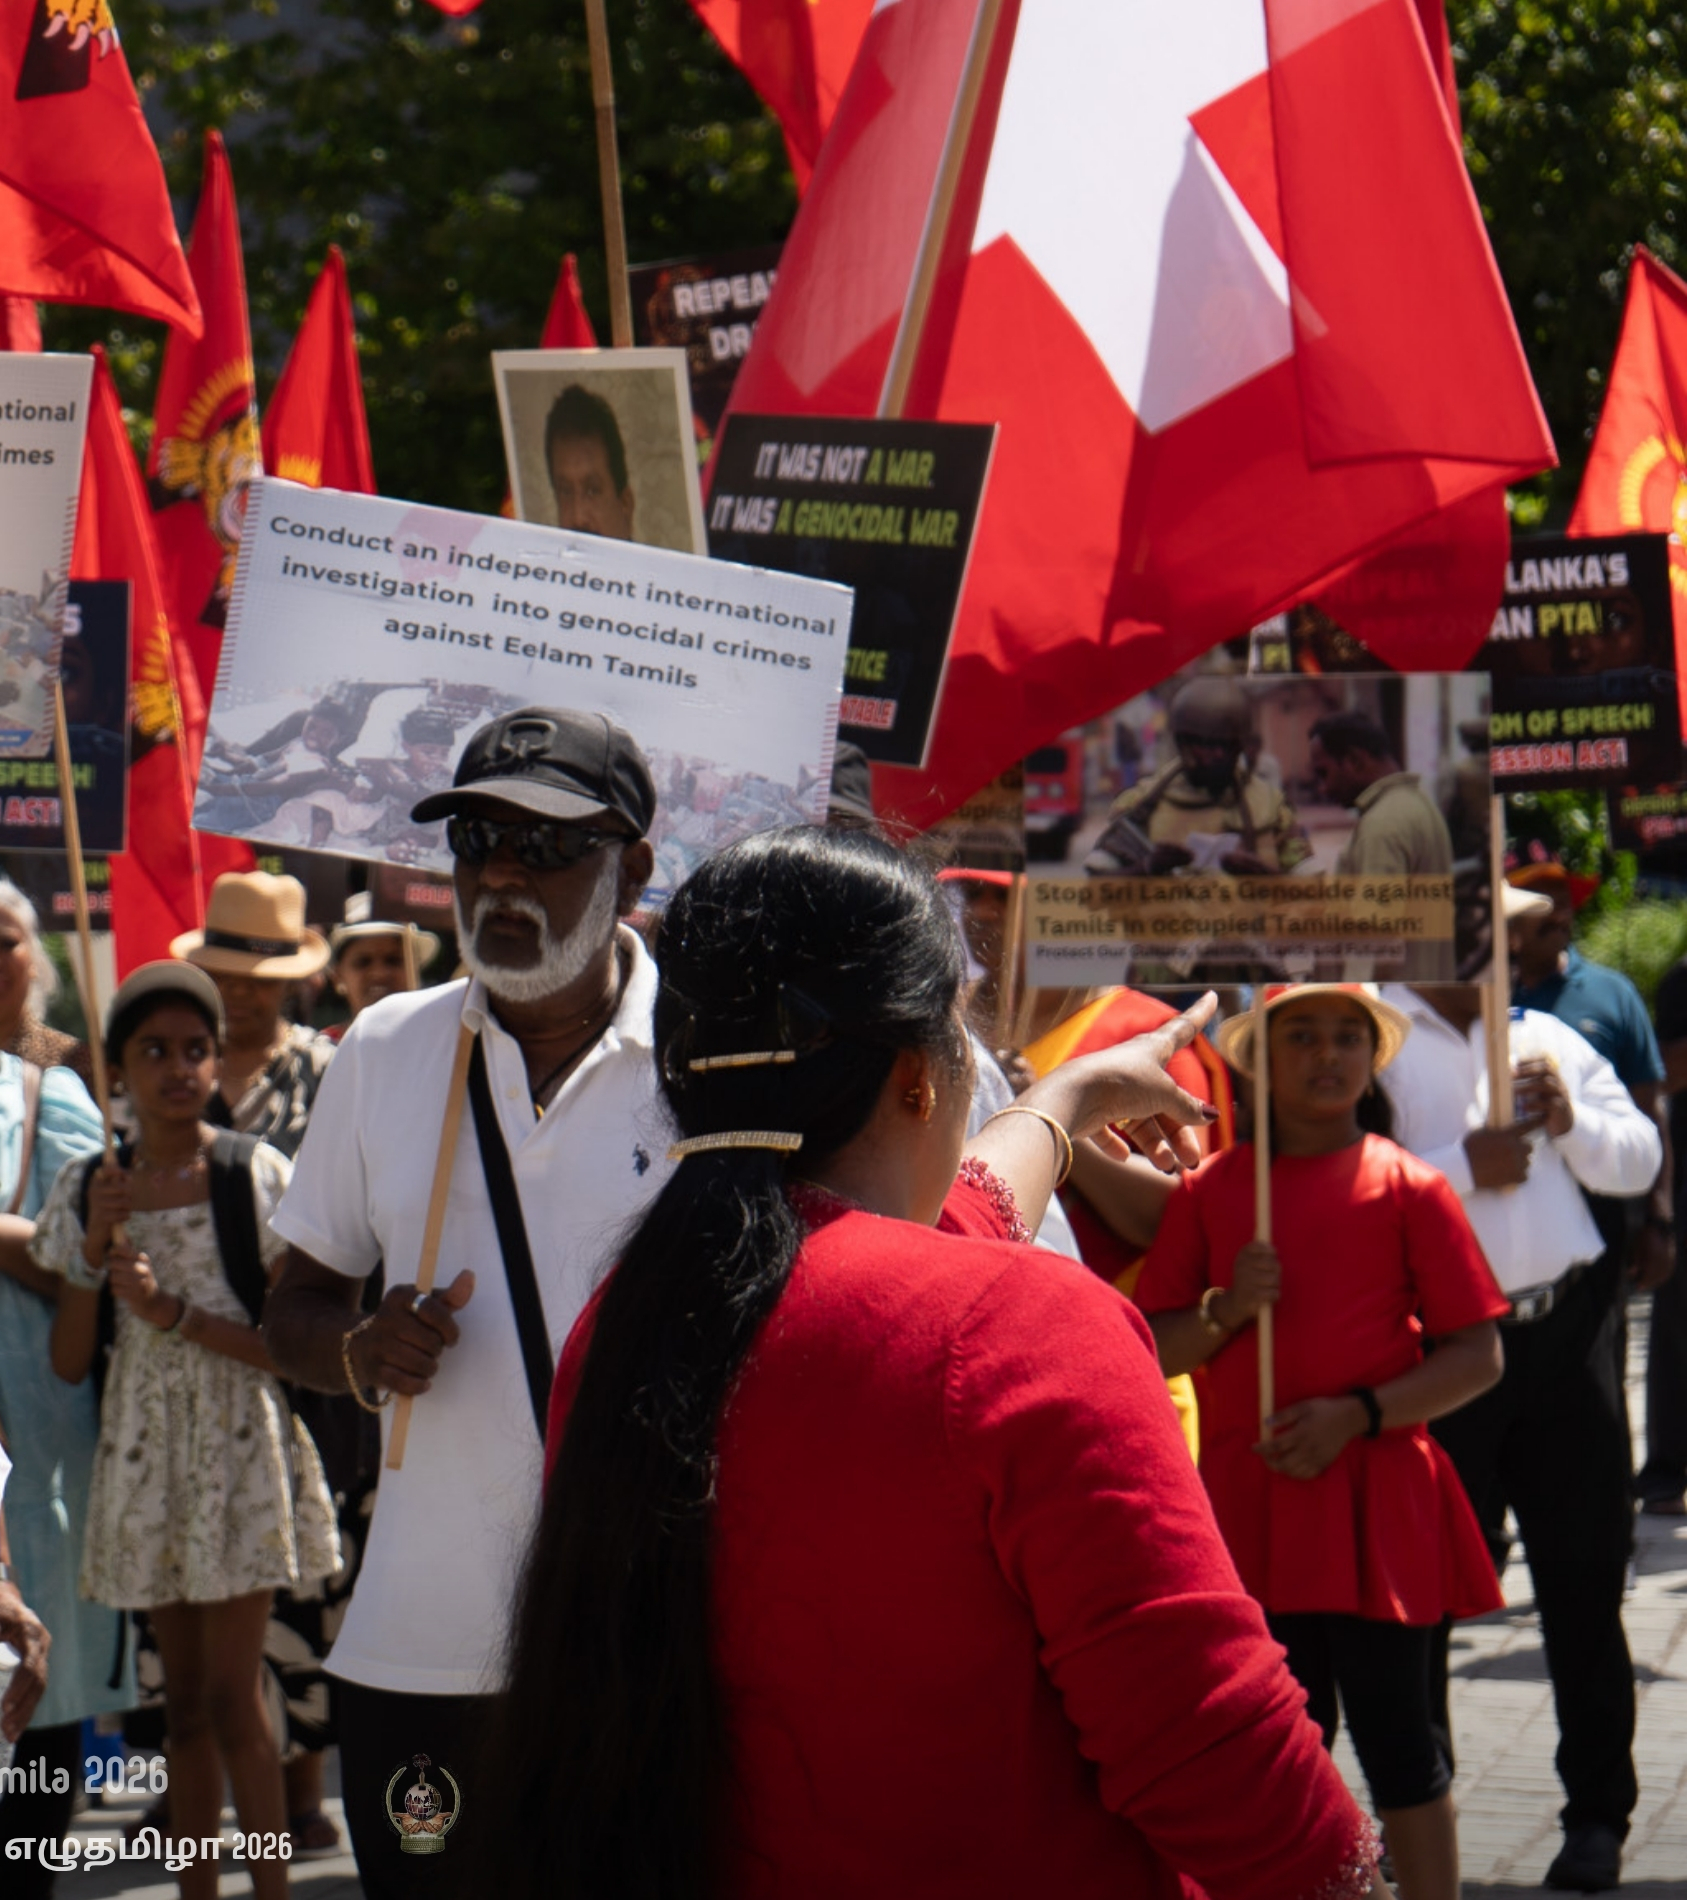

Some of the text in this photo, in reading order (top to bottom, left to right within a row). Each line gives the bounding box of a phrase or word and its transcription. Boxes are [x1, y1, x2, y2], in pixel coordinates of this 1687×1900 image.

[754, 442, 779, 479] IT
[777, 443, 822, 481] WAS
[821, 446, 867, 484] NOT
[864, 448, 883, 485] A
[710, 494, 733, 531] IT
[731, 496, 778, 534] WAS
[774, 498, 792, 535] A
[793, 502, 906, 544] GENOCIDAL
[270, 516, 835, 636] Conduct an independent international
[1505, 553, 1629, 593] LANKA'S
[282, 556, 812, 671] investigation into genocidal crimes
[1539, 602, 1602, 637] PTA!
[384, 617, 698, 688] against Eelam Tamils
[844, 648, 888, 680] TICE
[1527, 708, 1558, 738] OF
[1491, 741, 1573, 775] ESSION
[1036, 879, 1454, 907] Stop Sri Lanka's Genocide against
[1037, 914, 1116, 936] Tamils
[1152, 913, 1266, 938] occupied
